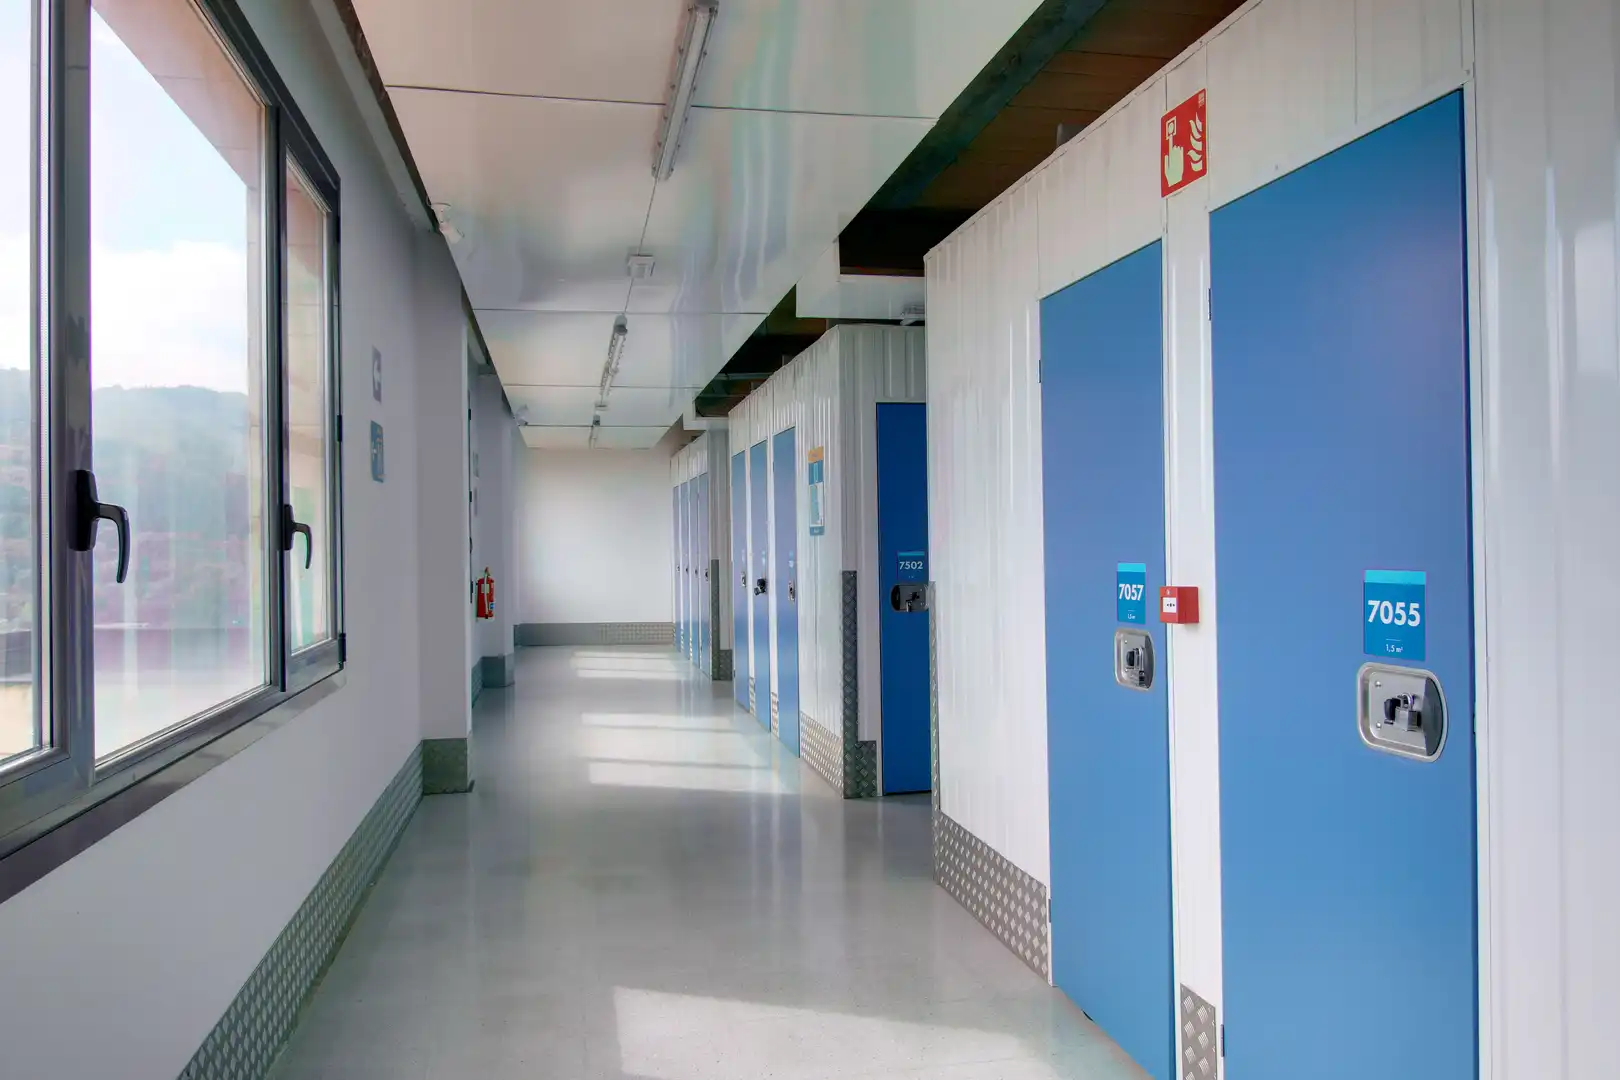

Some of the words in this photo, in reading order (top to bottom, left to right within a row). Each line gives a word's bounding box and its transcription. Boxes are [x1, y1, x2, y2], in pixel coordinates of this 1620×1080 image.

[899, 561, 924, 570] 7502
[1118, 583, 1144, 601] 7057
[1367, 599, 1421, 627] 7055
